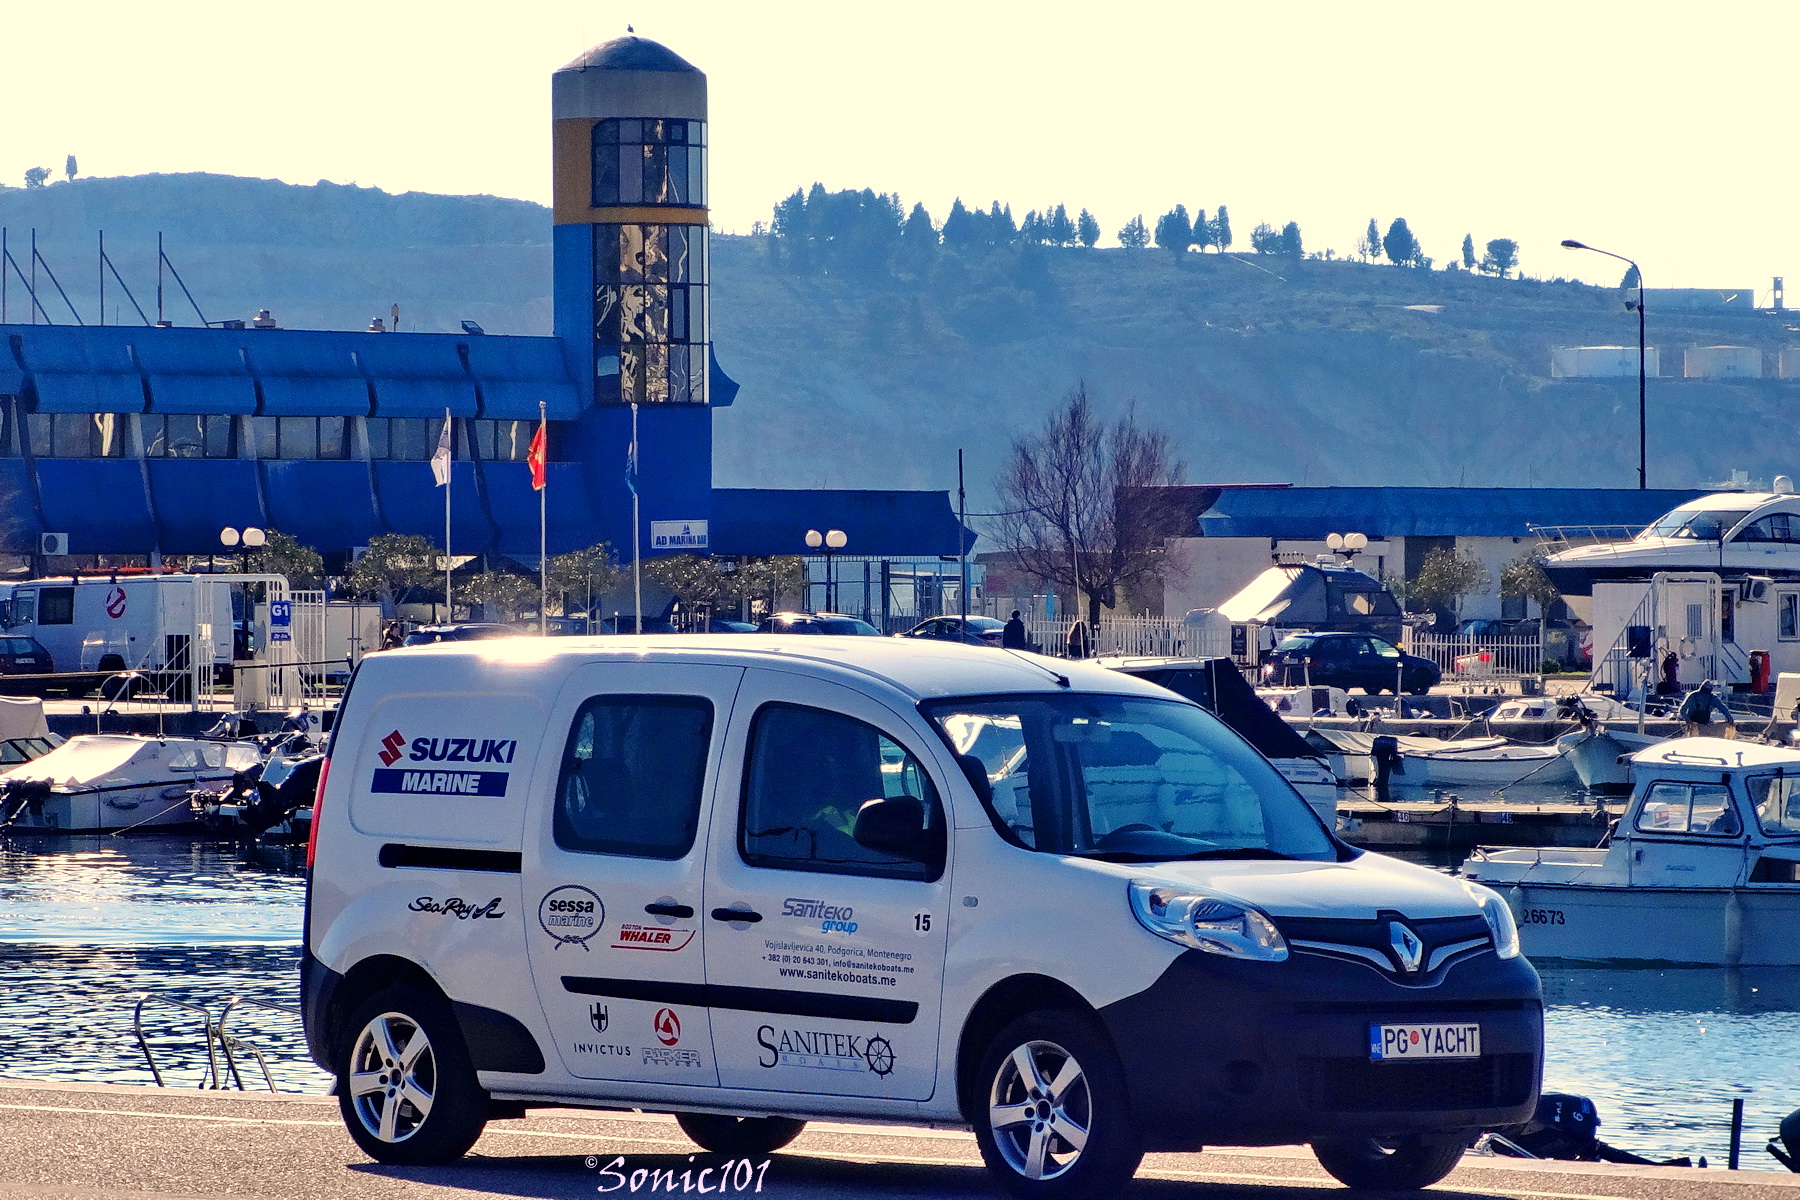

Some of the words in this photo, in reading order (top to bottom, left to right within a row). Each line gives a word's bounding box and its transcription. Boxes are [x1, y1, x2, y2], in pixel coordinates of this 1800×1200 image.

[656, 535, 667, 546] AD
[669, 535, 696, 546] MARINA
[271, 604, 289, 617] G1
[1235, 629, 1242, 638] P
[409, 737, 517, 764] SUZUKI
[401, 771, 481, 793] MARINE
[408, 896, 443, 913] Sea
[441, 898, 476, 920] Ray
[549, 899, 594, 913] sessa
[548, 913, 594, 928] marine
[821, 920, 858, 935] group
[914, 913, 931, 932] 15
[620, 930, 672, 944] WHALER
[815, 944, 826, 954] 40,
[827, 945, 866, 958] Podgorica,
[867, 948, 912, 962] Montenegro
[767, 953, 780, 962] 382
[782, 955, 791, 964] (0)
[792, 956, 801, 964] 20
[802, 956, 815, 965] 643
[816, 957, 832, 967] 301,
[832, 959, 915, 974] info@sanitekoboats.me
[779, 967, 897, 986] www.sanitekoboats.me
[1384, 1028, 1408, 1055] PG
[1421, 1027, 1477, 1054] YACHT
[573, 1043, 631, 1056] INVICTUS
